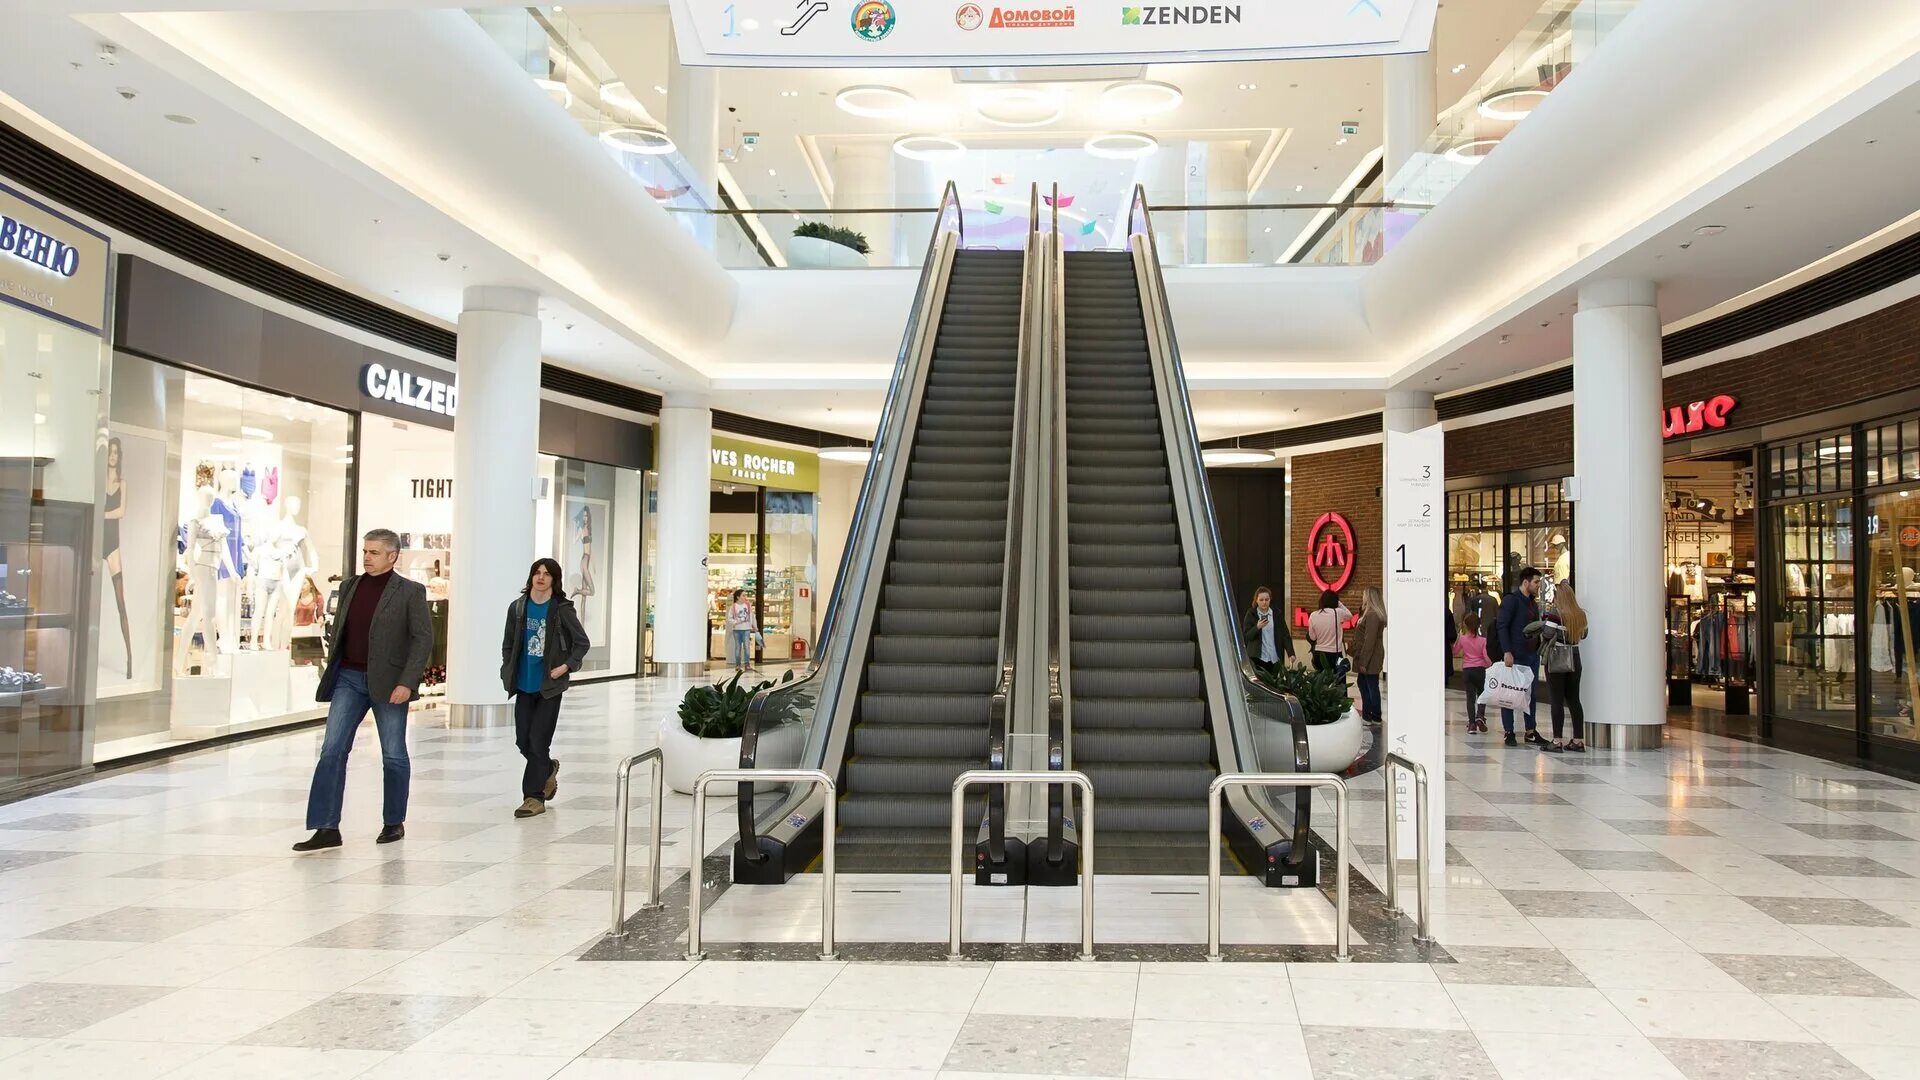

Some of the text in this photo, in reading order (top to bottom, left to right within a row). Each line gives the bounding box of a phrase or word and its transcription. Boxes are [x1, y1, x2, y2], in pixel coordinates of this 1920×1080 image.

[1143, 5, 1241, 25] ZENDEN
[1190, 165, 1197, 177] 2
[0, 216, 79, 277] ВЕНЮ
[712, 448, 795, 476] VES ROCHER
[732, 468, 767, 481] FRANCE
[1422, 465, 1431, 479] 3
[411, 479, 453, 498] TIGHT
[1422, 504, 1431, 517] 2
[1395, 544, 1412, 573] 1
[1501, 683, 1528, 692] house
[1396, 734, 1407, 823] РИВЬРА
